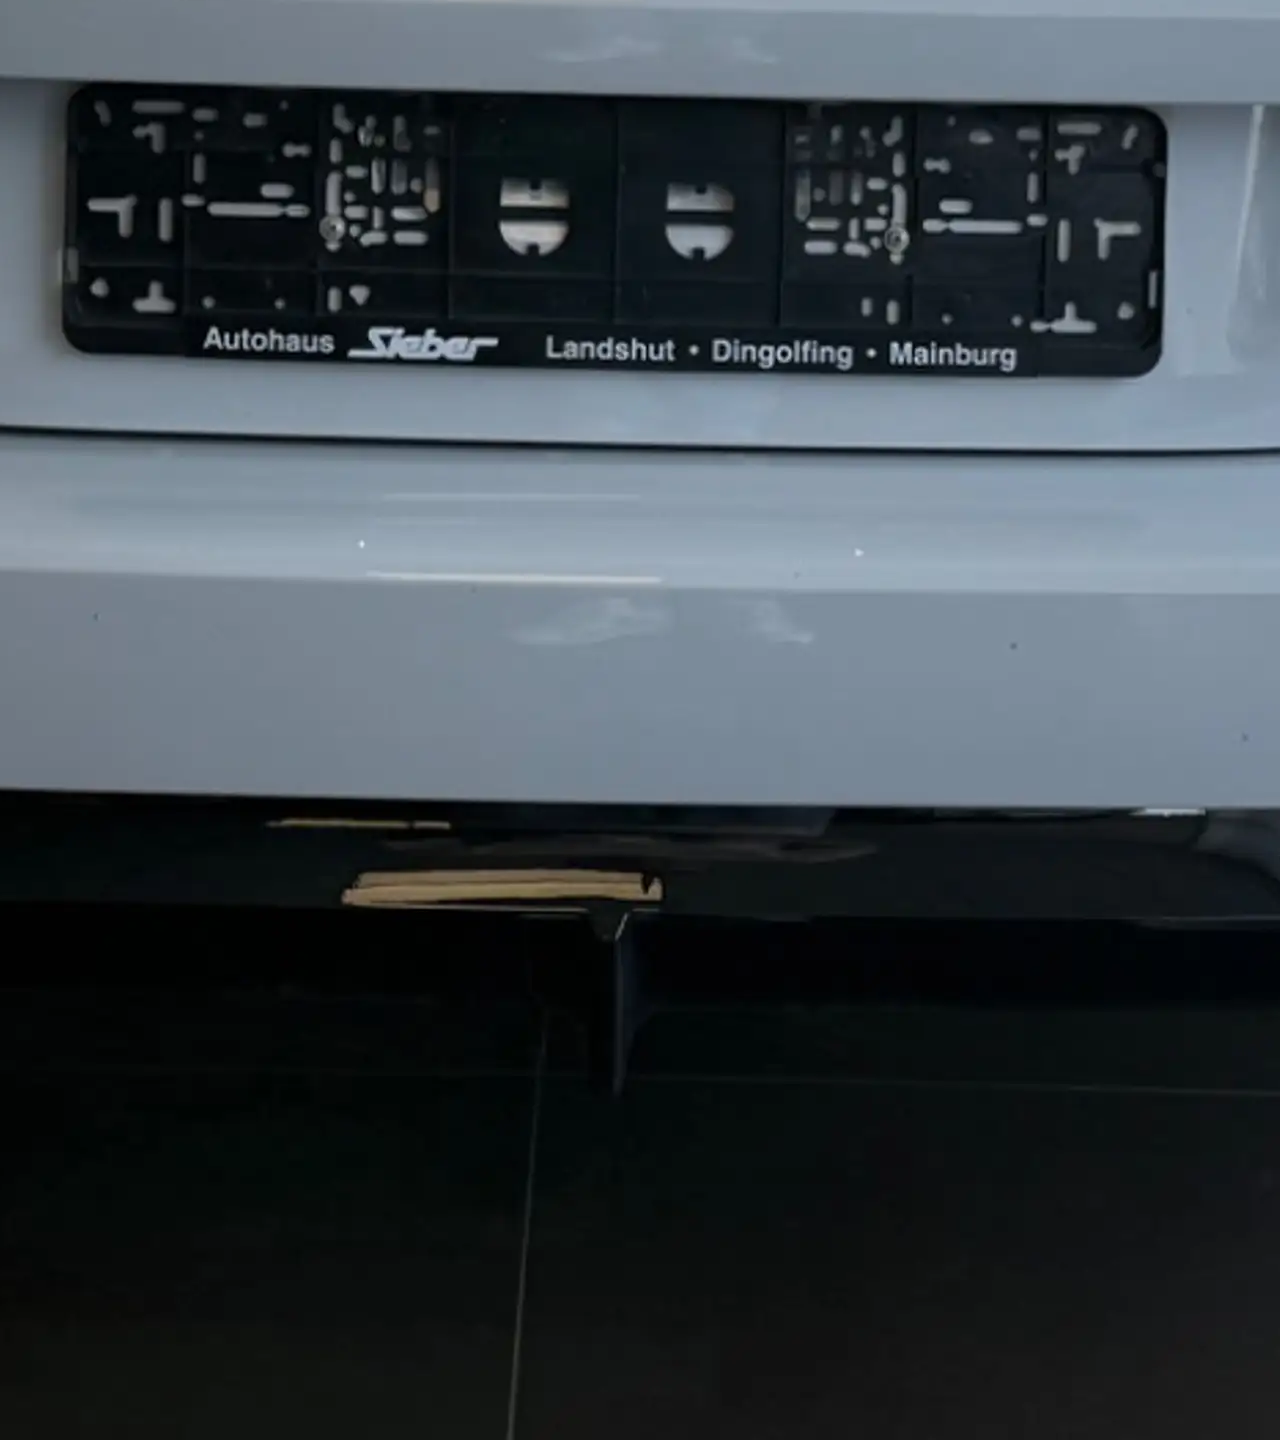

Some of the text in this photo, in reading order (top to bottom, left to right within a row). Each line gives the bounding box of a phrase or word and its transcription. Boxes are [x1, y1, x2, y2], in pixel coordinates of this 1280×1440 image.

[202, 325, 1018, 372] Autohaus Sieber Landshut Dingolfing Mainburg
